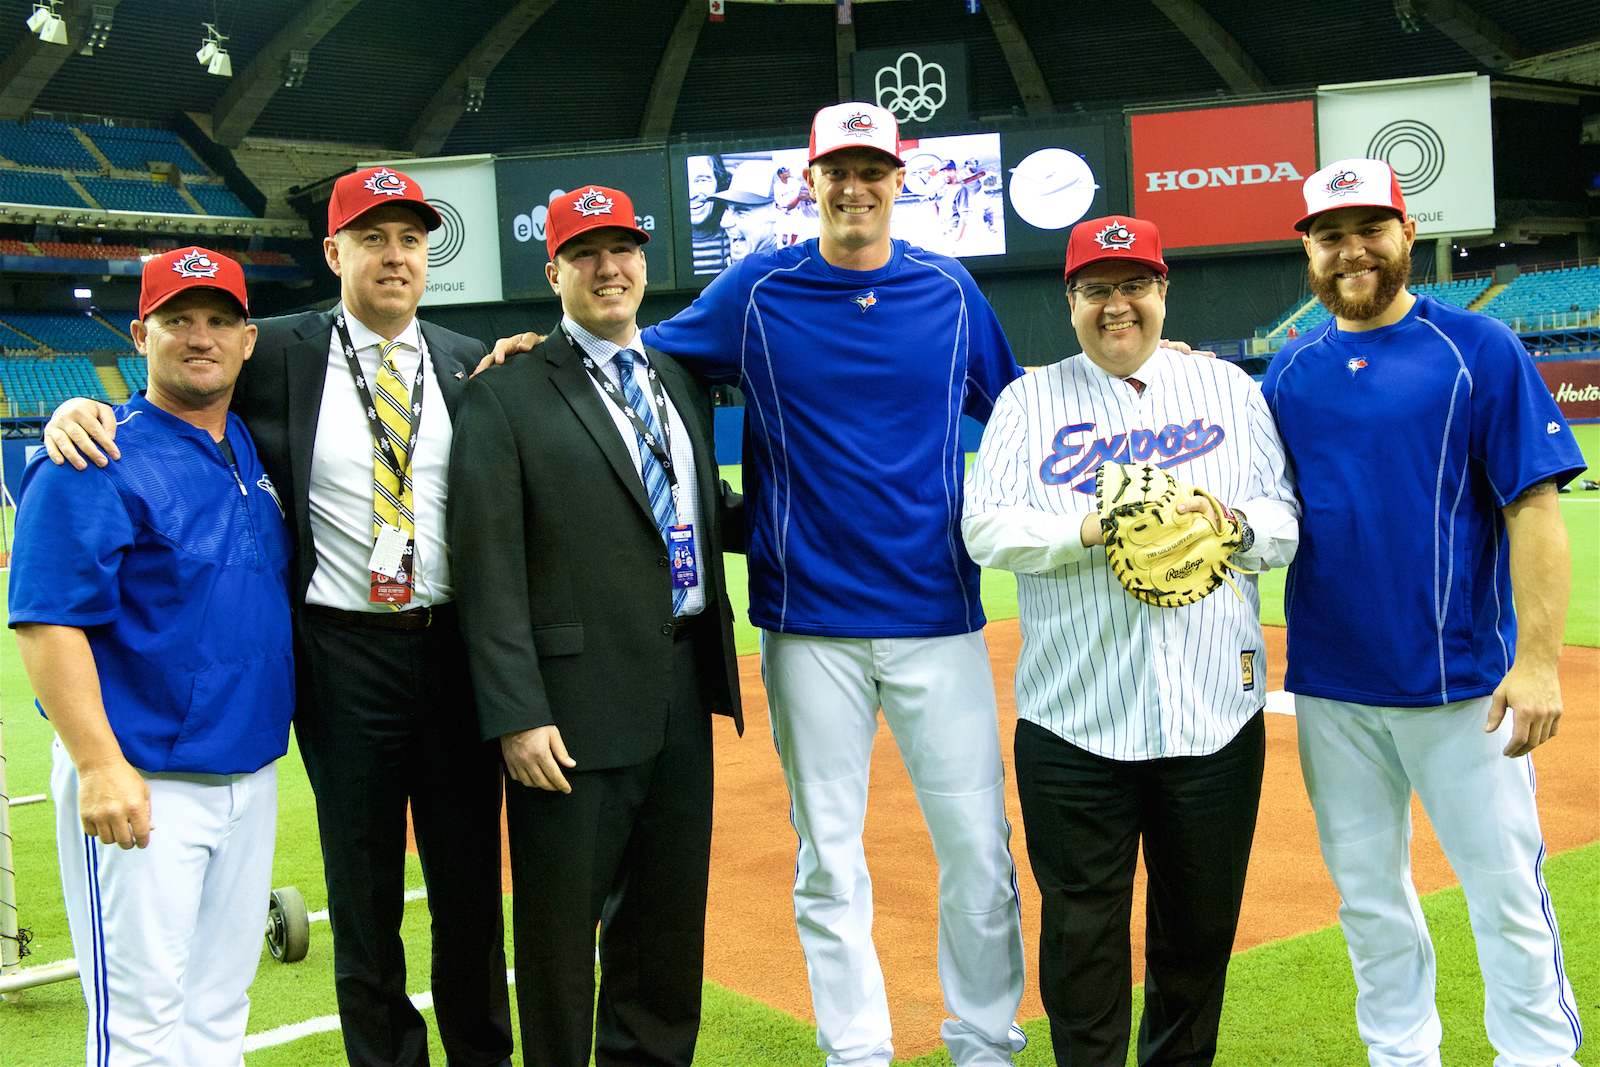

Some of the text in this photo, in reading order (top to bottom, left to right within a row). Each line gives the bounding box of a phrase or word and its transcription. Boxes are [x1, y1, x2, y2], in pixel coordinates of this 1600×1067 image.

[1145, 161, 1304, 192] HONDA
[1406, 211, 1444, 223] PIQUE
[425, 281, 465, 293] MPIQUE
[1556, 382, 1600, 403] Horto
[1039, 418, 1226, 495] Expos
[1157, 546, 1172, 555] GOLD
[1165, 557, 1205, 582] Rawlings
